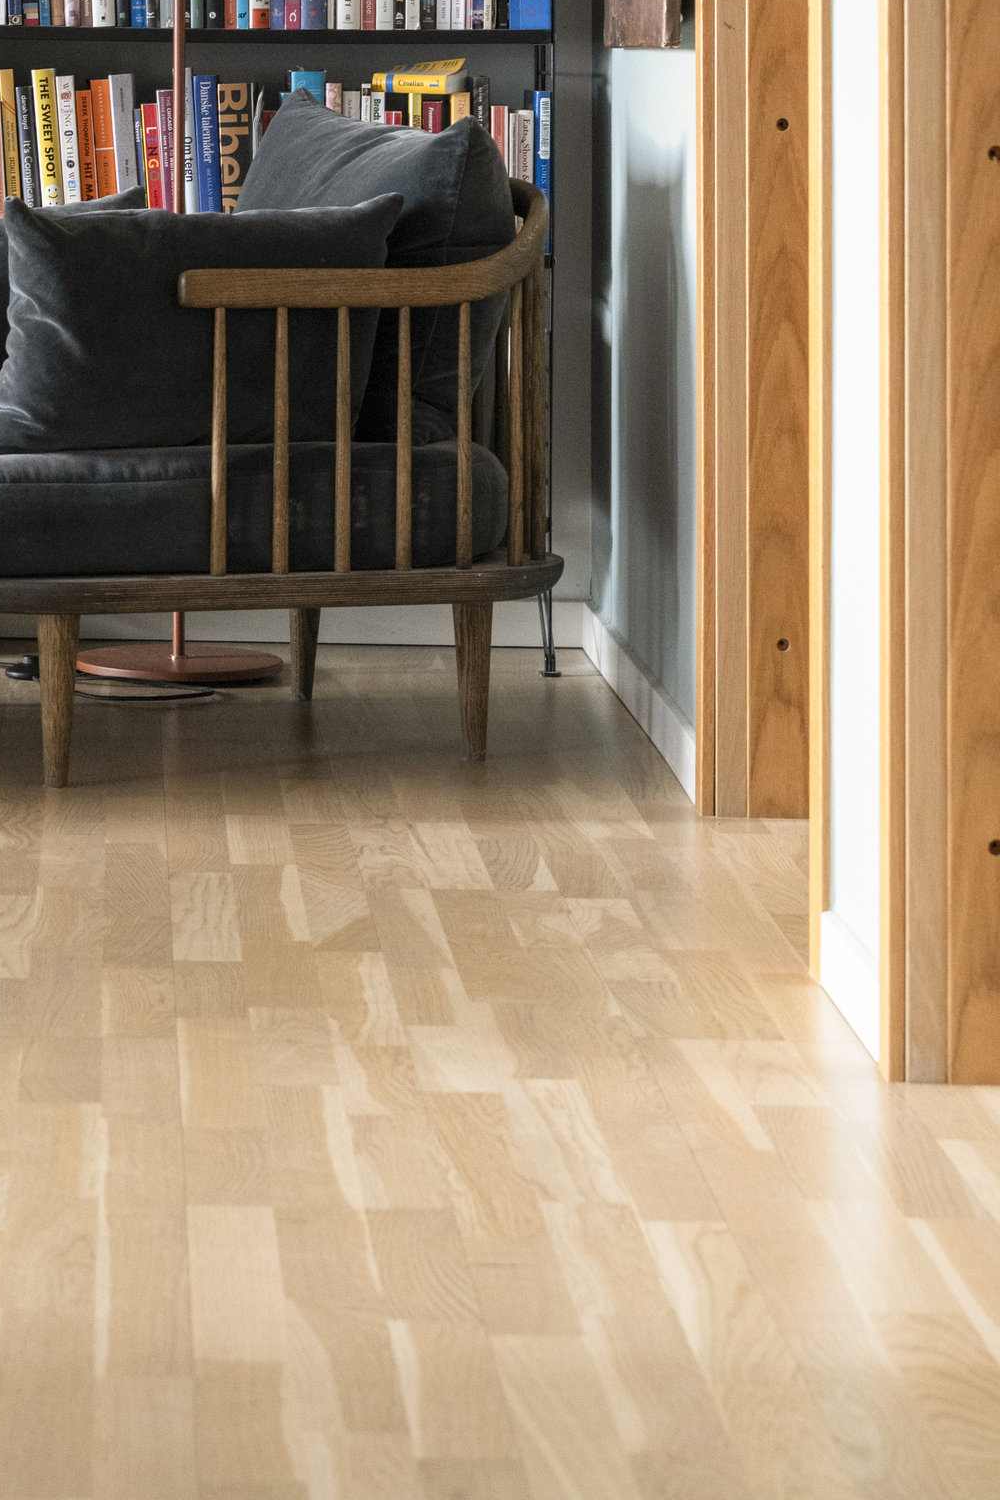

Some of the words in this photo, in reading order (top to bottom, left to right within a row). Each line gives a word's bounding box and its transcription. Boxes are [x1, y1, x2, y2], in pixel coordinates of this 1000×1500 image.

[40, 77, 49, 99] THE
[200, 82, 211, 115] Danske
[398, 79, 424, 87] Croatian
[42, 103, 53, 144] SWEET
[202, 117, 214, 163] talemåder
[44, 147, 56, 180] SPOT
[146, 127, 160, 182] LINGO
